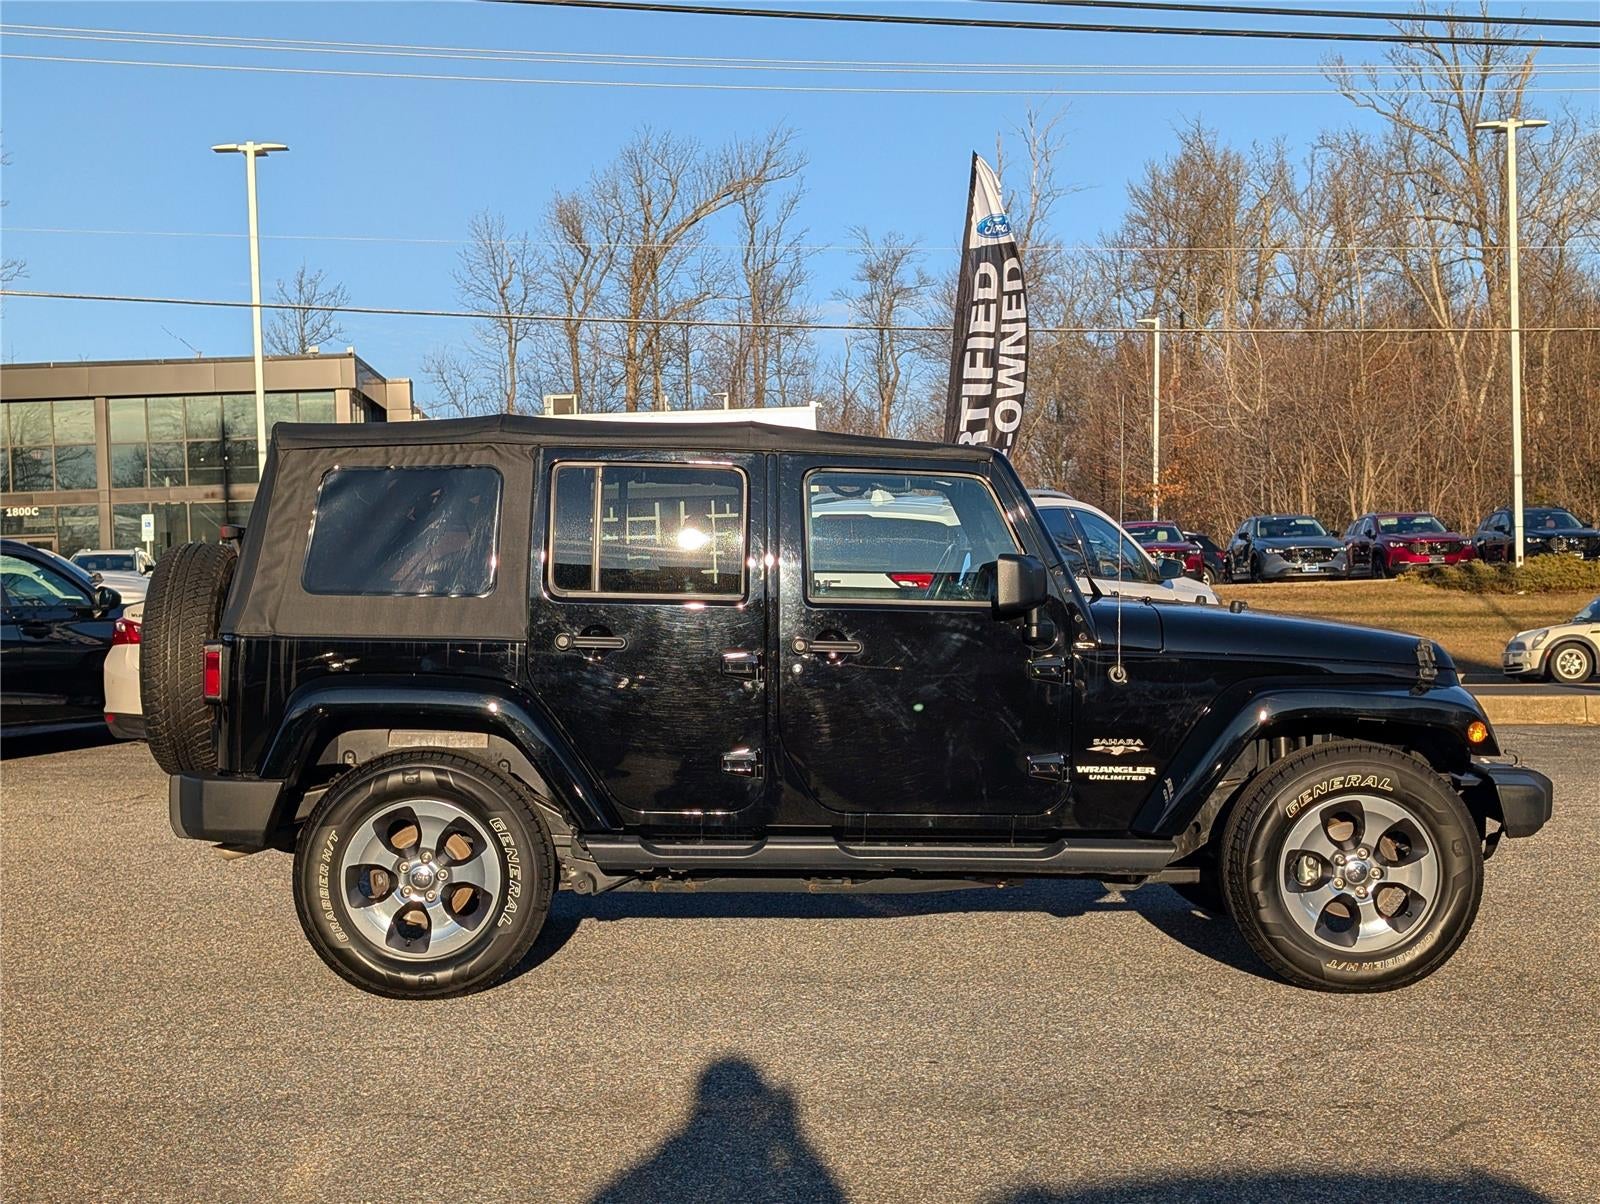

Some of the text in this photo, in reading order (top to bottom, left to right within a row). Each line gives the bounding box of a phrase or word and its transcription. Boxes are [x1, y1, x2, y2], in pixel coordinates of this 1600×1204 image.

[984, 215, 1011, 236] Ford
[984, 257, 1027, 456] -OWNED
[6, 506, 40, 517] 1800C
[1092, 738, 1144, 746] SAHARA
[1076, 765, 1157, 775] WRANGLER
[1285, 774, 1394, 819] GENERAL
[318, 829, 349, 944] GRABBER H/T
[489, 816, 521, 929] GENERAL
